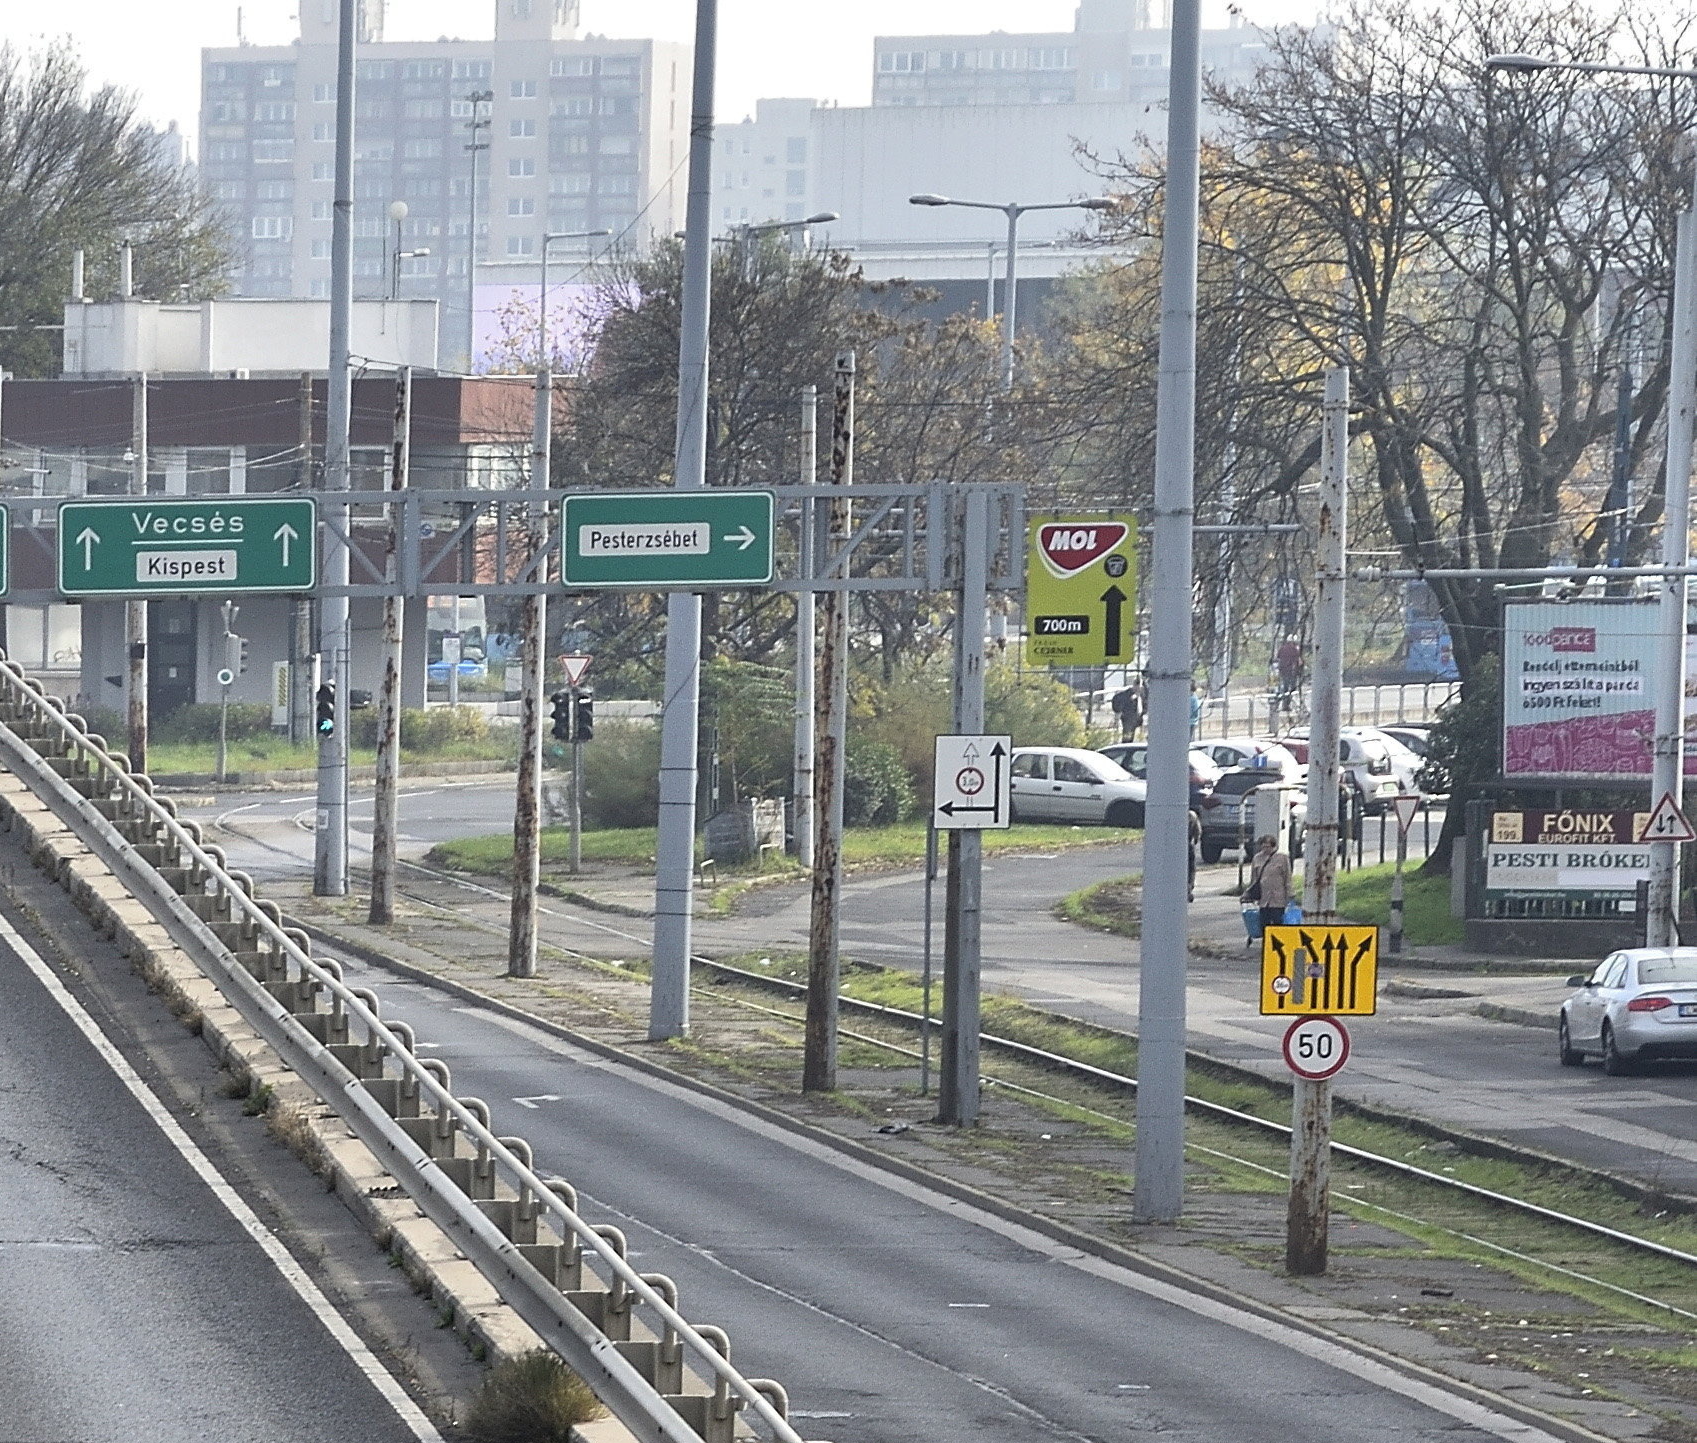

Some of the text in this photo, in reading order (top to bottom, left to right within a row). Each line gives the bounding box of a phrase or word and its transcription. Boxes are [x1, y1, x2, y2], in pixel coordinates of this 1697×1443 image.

[132, 511, 244, 534] Vecsés
[591, 529, 698, 549] Pesterzsébet
[1049, 530, 1098, 551] MOL
[148, 557, 225, 579] Kispest
[1543, 810, 1614, 833] FŐNIX
[1538, 833, 1589, 844] EUROFIT
[1492, 850, 1650, 868] PESTI BRÓKE
[1299, 1034, 1333, 1059] 50
